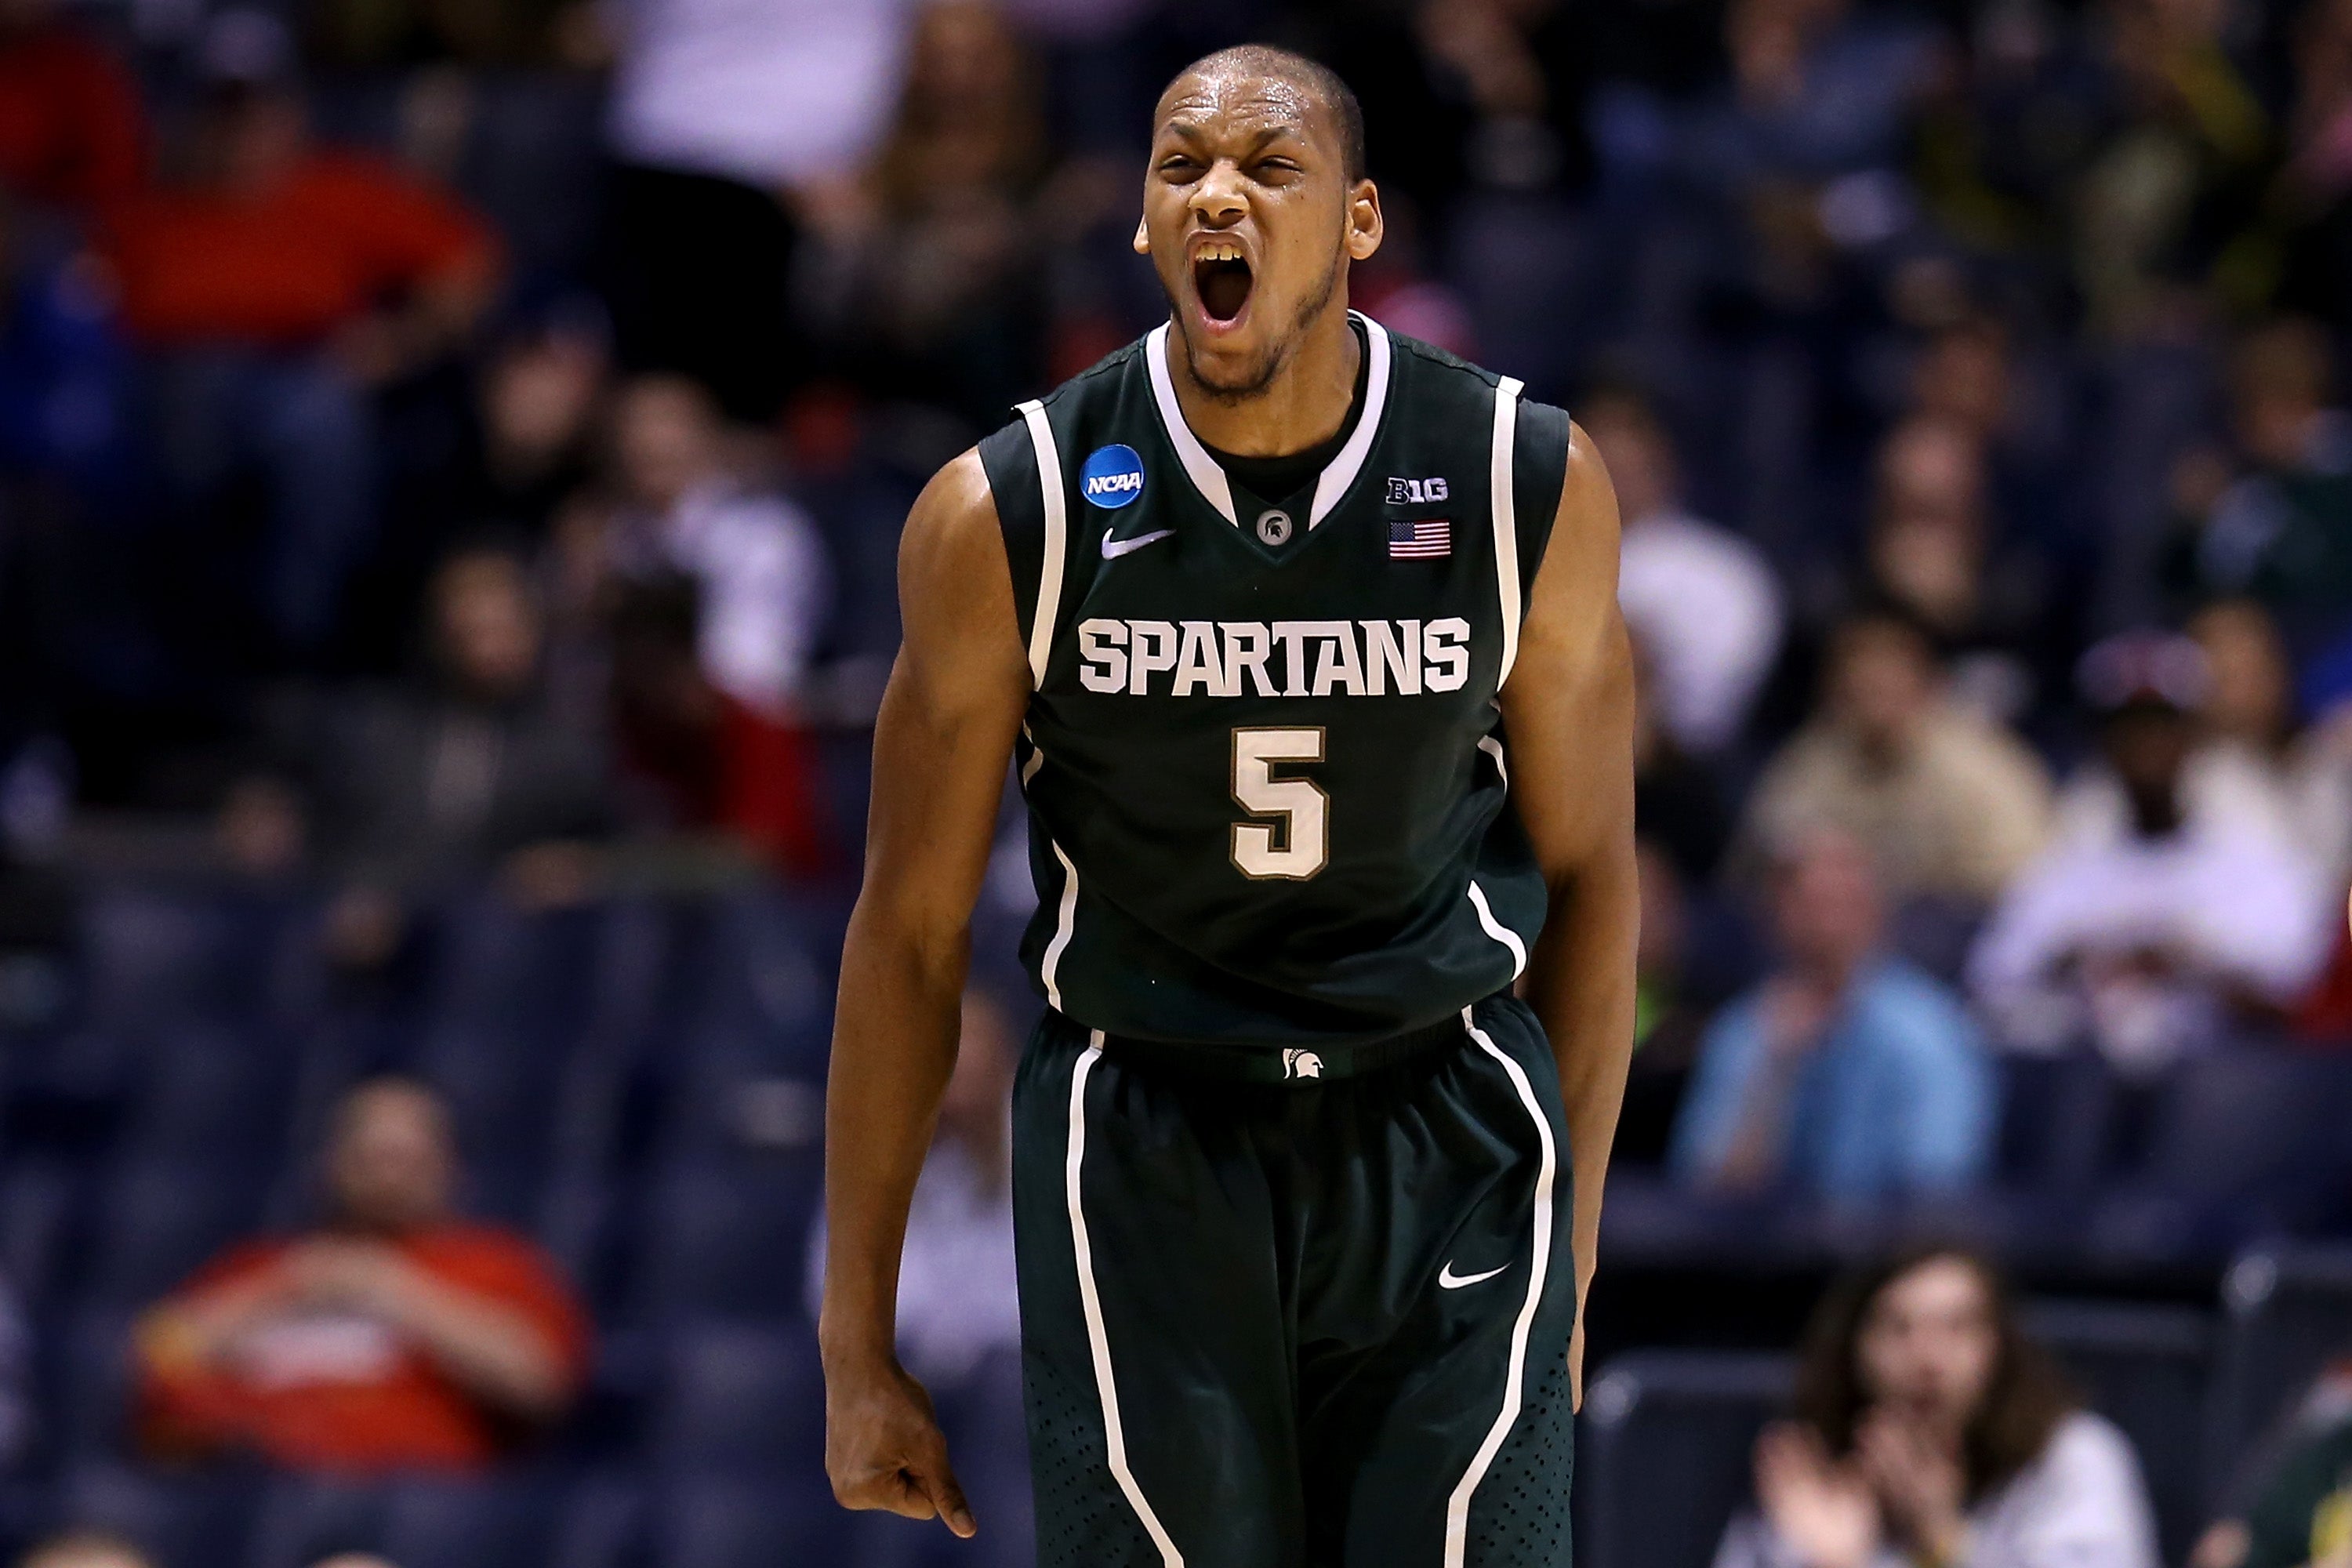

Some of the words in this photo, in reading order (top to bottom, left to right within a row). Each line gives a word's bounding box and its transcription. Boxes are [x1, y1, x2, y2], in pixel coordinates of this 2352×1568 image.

[1087, 472, 1142, 495] NCAA
[1078, 617, 1470, 697] SPARTANS
[1229, 725, 1330, 880] 5
